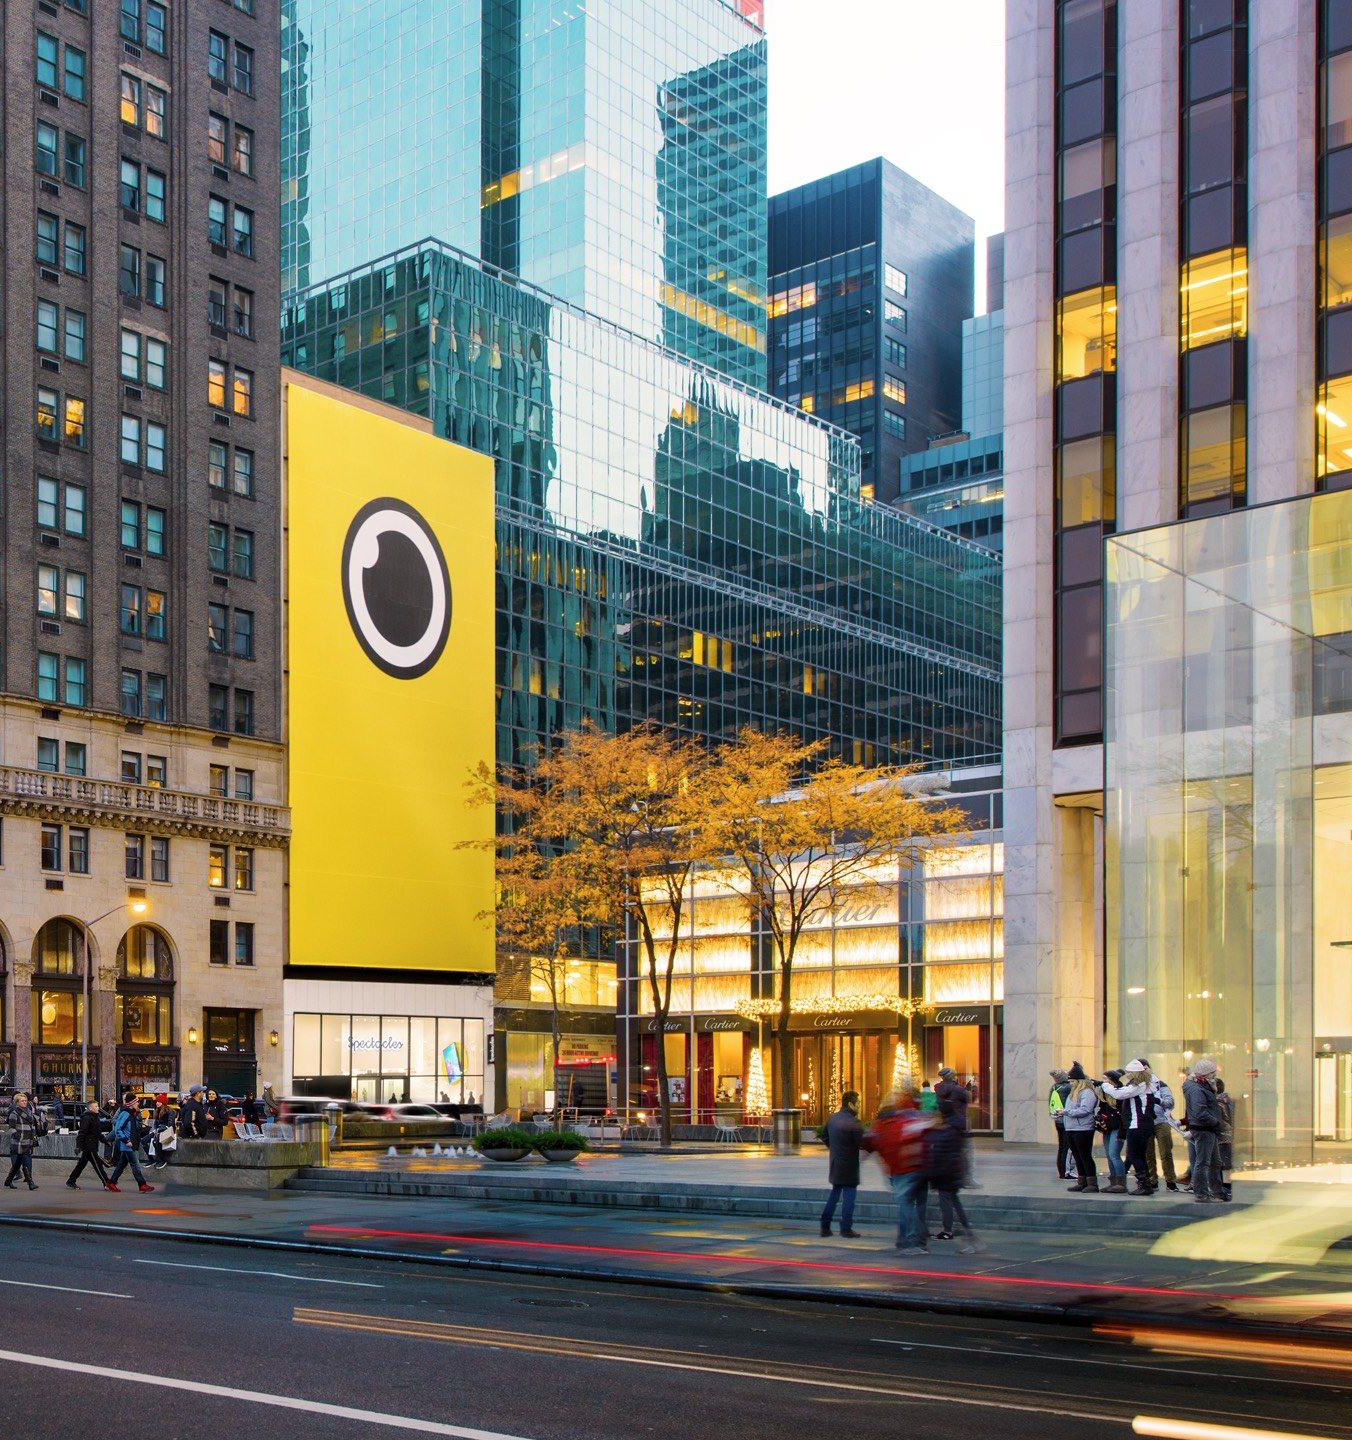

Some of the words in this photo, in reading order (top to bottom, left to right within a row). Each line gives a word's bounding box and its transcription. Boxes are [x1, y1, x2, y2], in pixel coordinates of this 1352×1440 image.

[814, 1015, 852, 1027] Cartier
[935, 1010, 978, 1023] Cartier
[648, 1019, 682, 1031] Catier
[704, 1018, 740, 1030] Cartier
[347, 1036, 403, 1051] Spectacles
[126, 1064, 168, 1073] GHURKA
